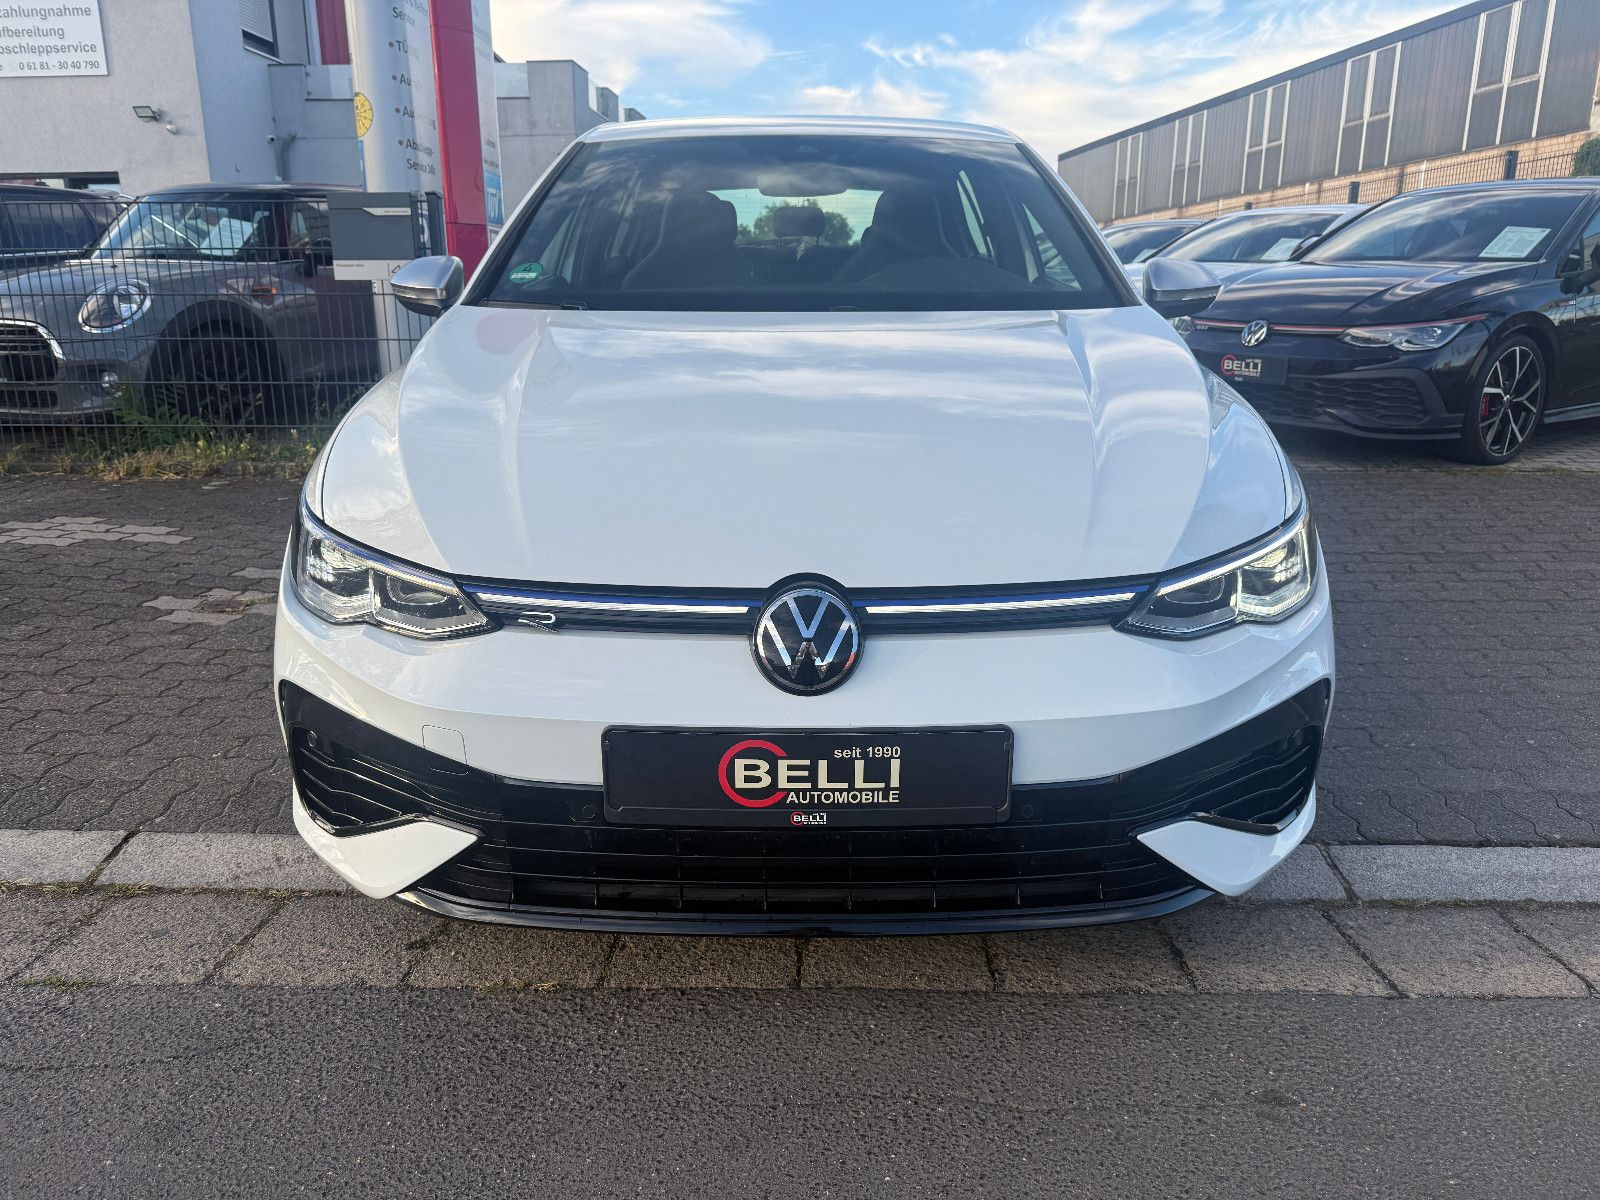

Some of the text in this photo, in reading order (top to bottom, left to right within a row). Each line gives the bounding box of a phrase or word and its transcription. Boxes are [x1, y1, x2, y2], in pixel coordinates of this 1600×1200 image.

[1223, 359, 1261, 373] BELLI
[833, 746, 901, 759] seit 1990
[734, 758, 900, 789] BELLI
[786, 790, 900, 804] AUTOMOBILE
[793, 814, 827, 822] BELLI
